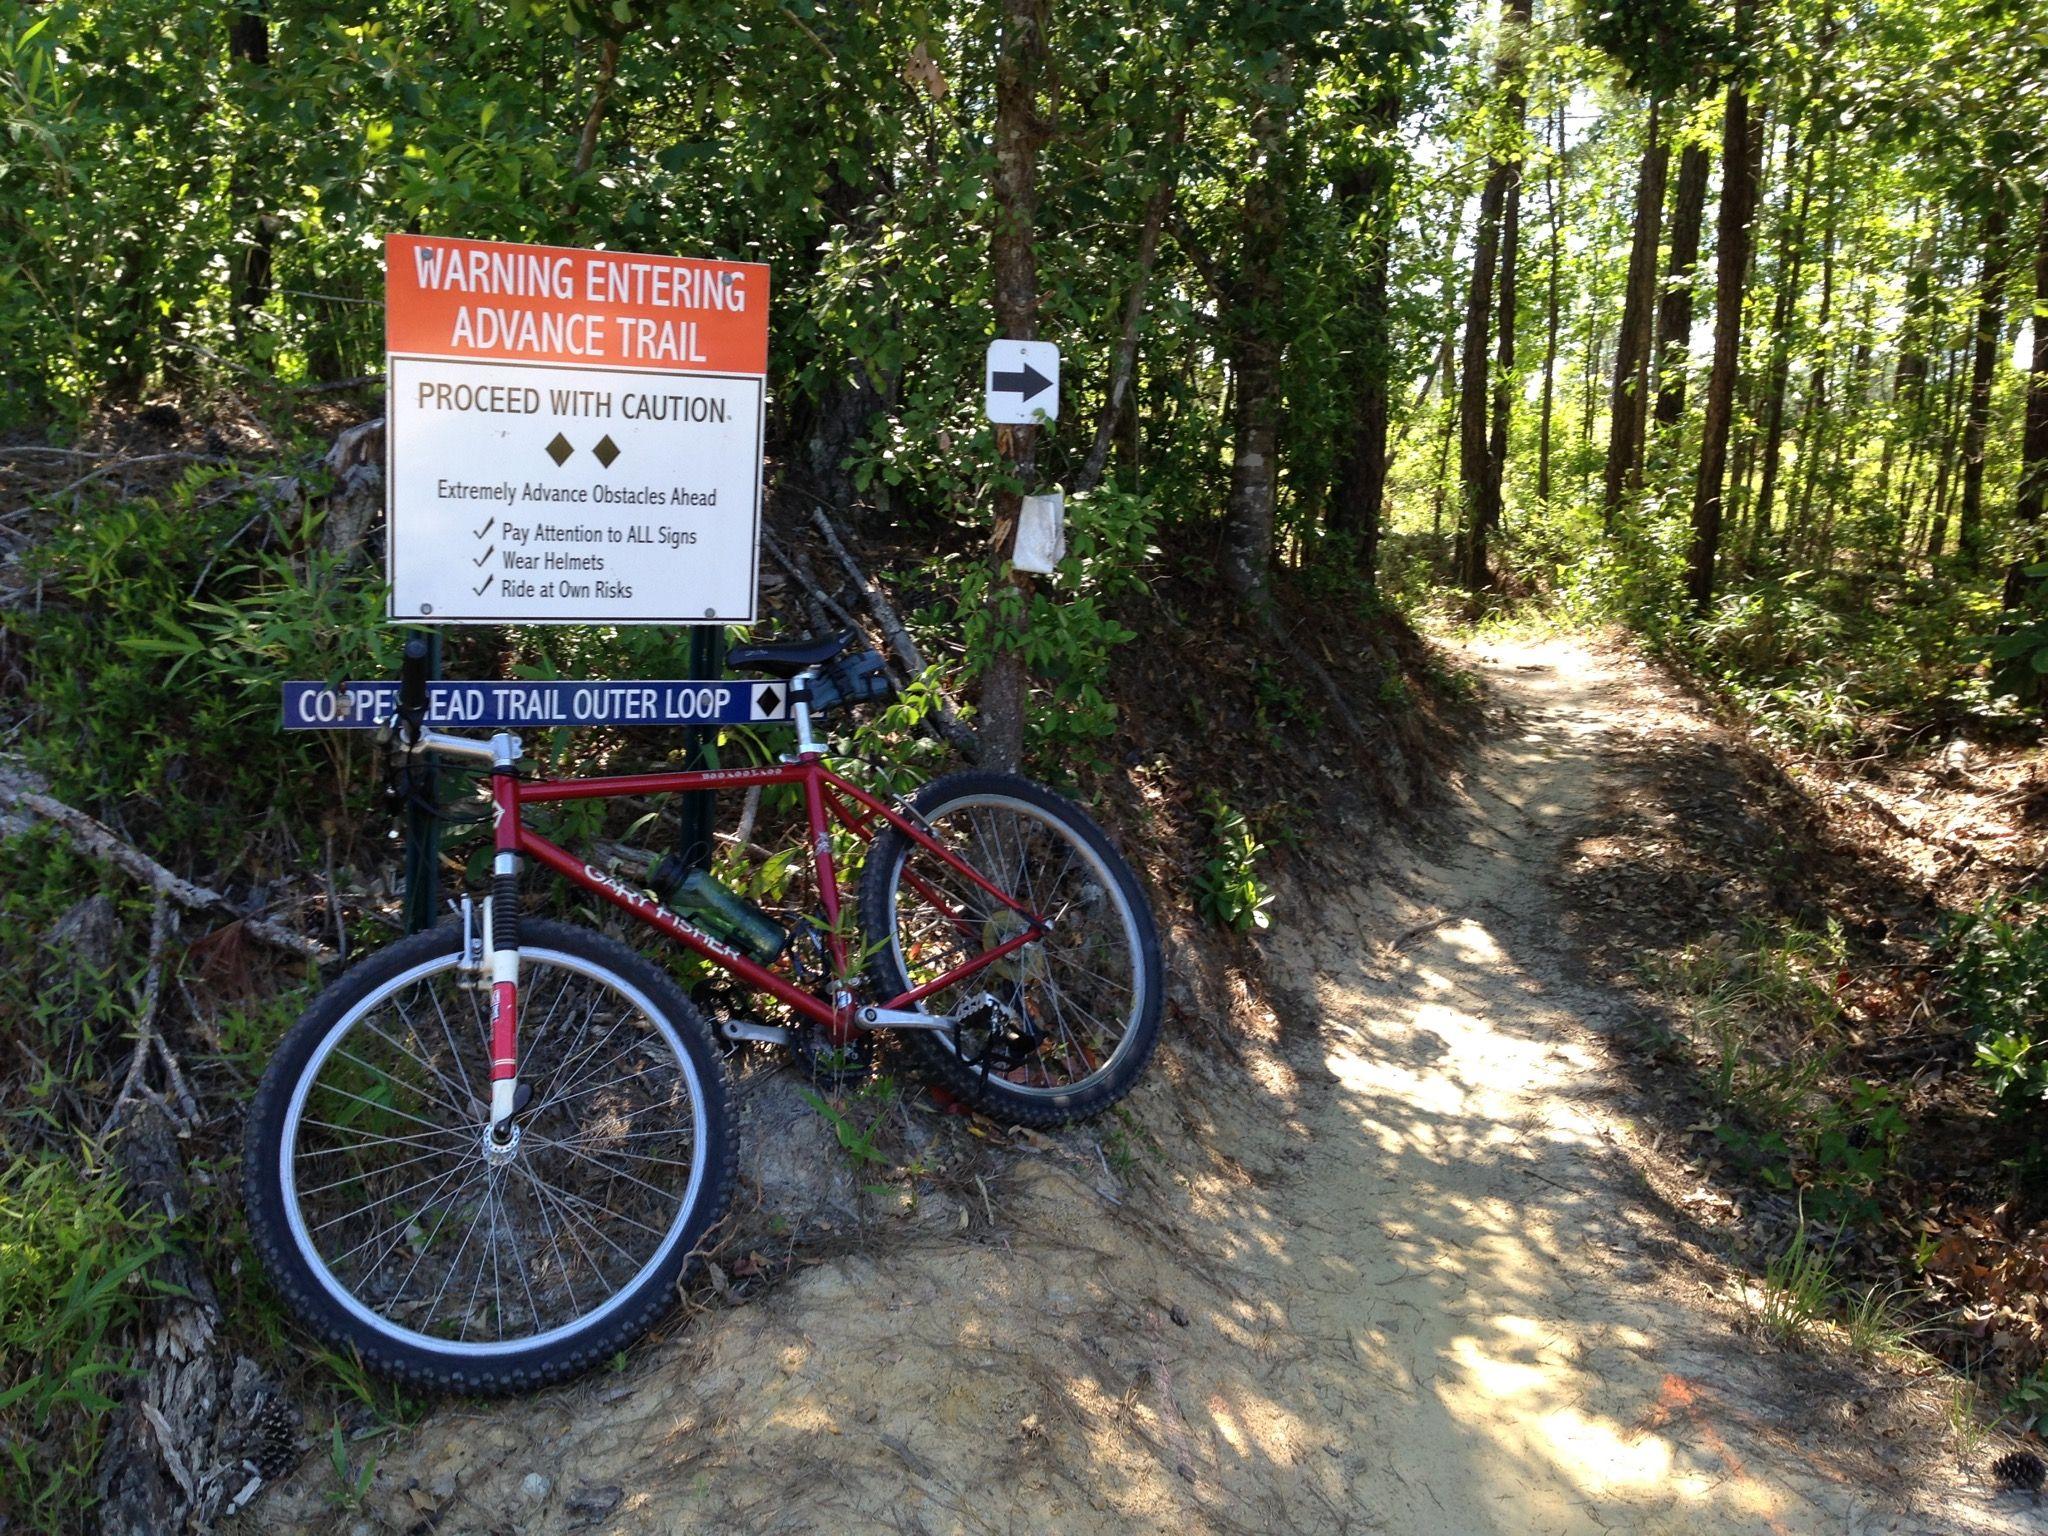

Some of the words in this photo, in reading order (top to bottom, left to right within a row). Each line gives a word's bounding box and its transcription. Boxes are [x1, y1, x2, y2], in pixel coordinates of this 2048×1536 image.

[414, 246, 573, 299] WARNING
[587, 260, 745, 311] ENTERING
[451, 306, 605, 355] ADVANCE
[616, 317, 707, 362] TRAIL
[418, 382, 539, 414] PROCEED
[550, 389, 611, 418] WITH
[438, 480, 516, 505] Extremely
[522, 483, 587, 503] Advance
[593, 485, 666, 505] Obstacles
[671, 487, 716, 506] Ahead
[503, 523, 528, 546] Pay
[534, 525, 602, 542] Attention
[608, 527, 622, 543] to
[627, 526, 653, 543] ALL
[659, 527, 697, 549] Signs
[503, 552, 540, 569] Wear
[544, 552, 604, 570] Helmets
[502, 580, 534, 597] Ride
[540, 583, 554, 598] at
[559, 582, 589, 598] Own
[595, 581, 632, 598] Risks
[299, 689, 484, 722] COPEEAD
[492, 689, 567, 720] TRAIL
[573, 689, 657, 719] OUTER
[666, 689, 731, 718] LOOP
[584, 865, 650, 907] GARY
[656, 906, 740, 960] FISHER
